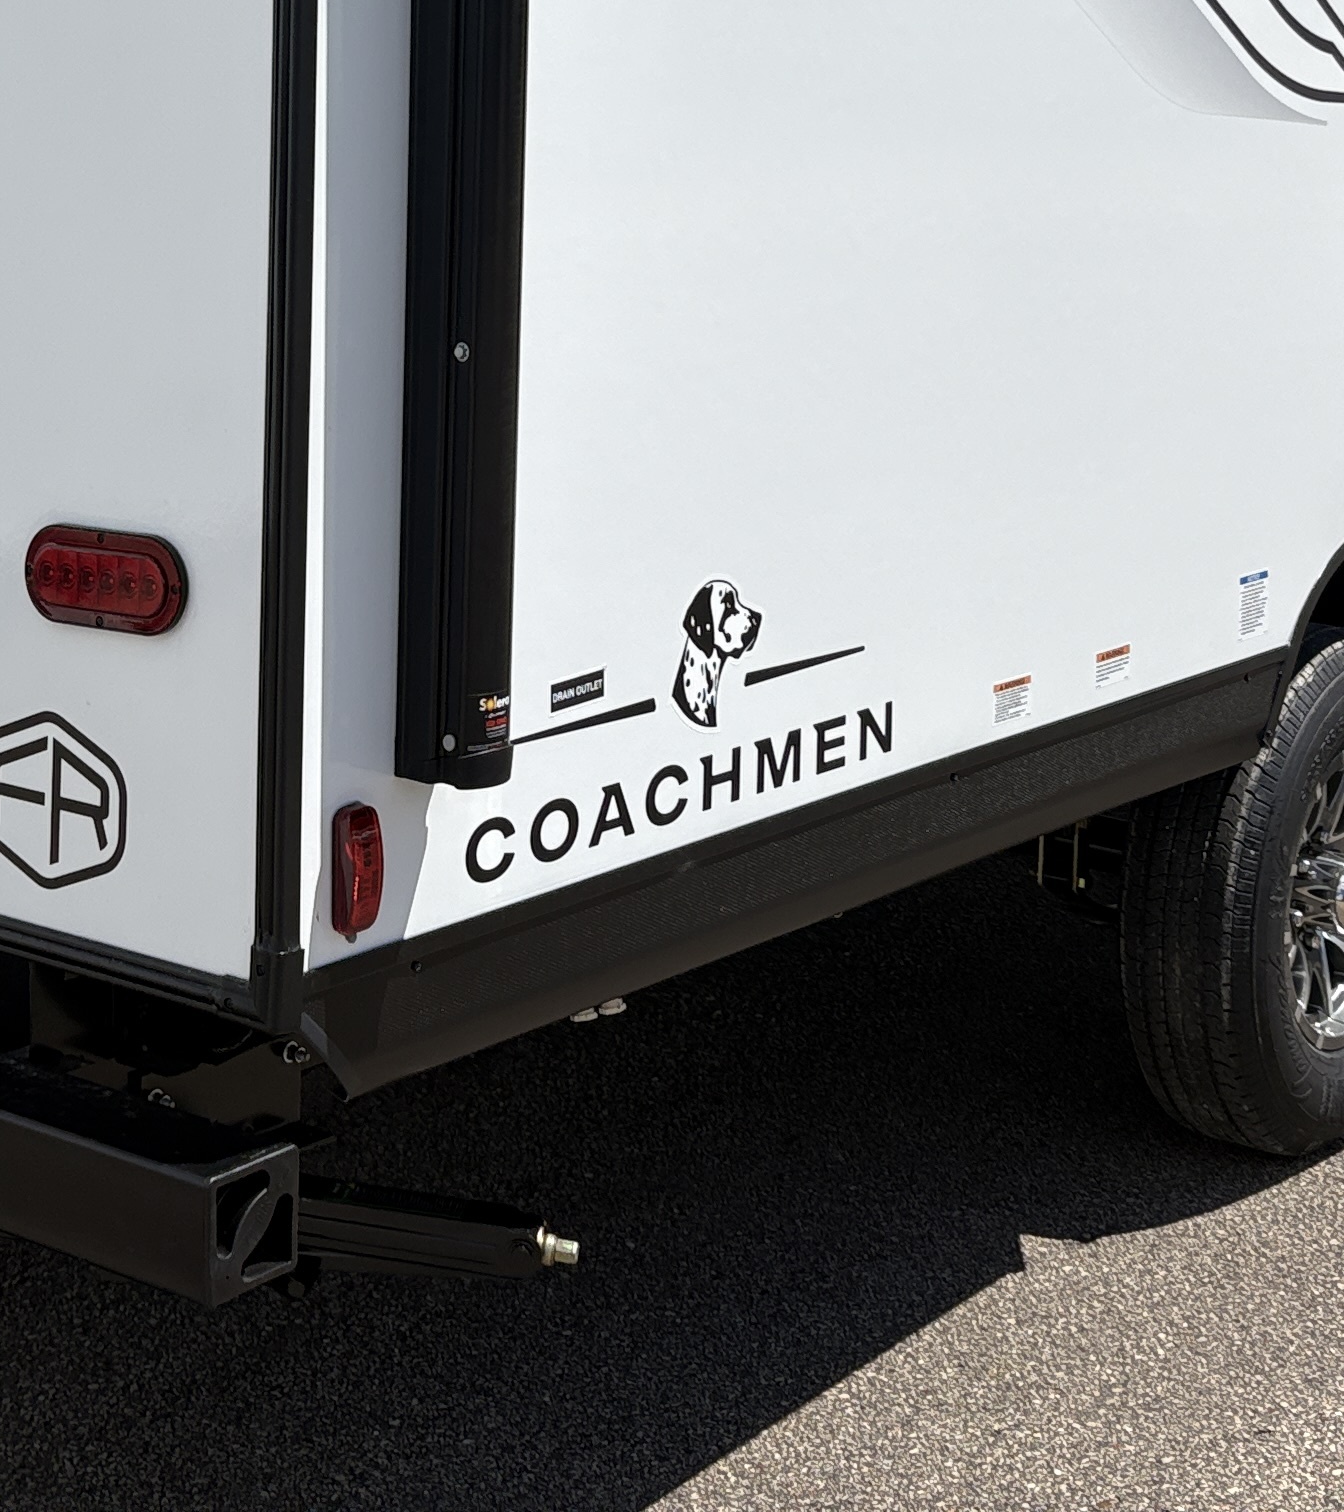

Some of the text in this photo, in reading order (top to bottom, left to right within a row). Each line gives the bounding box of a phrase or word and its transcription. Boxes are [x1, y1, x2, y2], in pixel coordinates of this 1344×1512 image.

[552, 678, 603, 704] DRAIN OUTLET
[464, 700, 895, 884] COACHMEN
